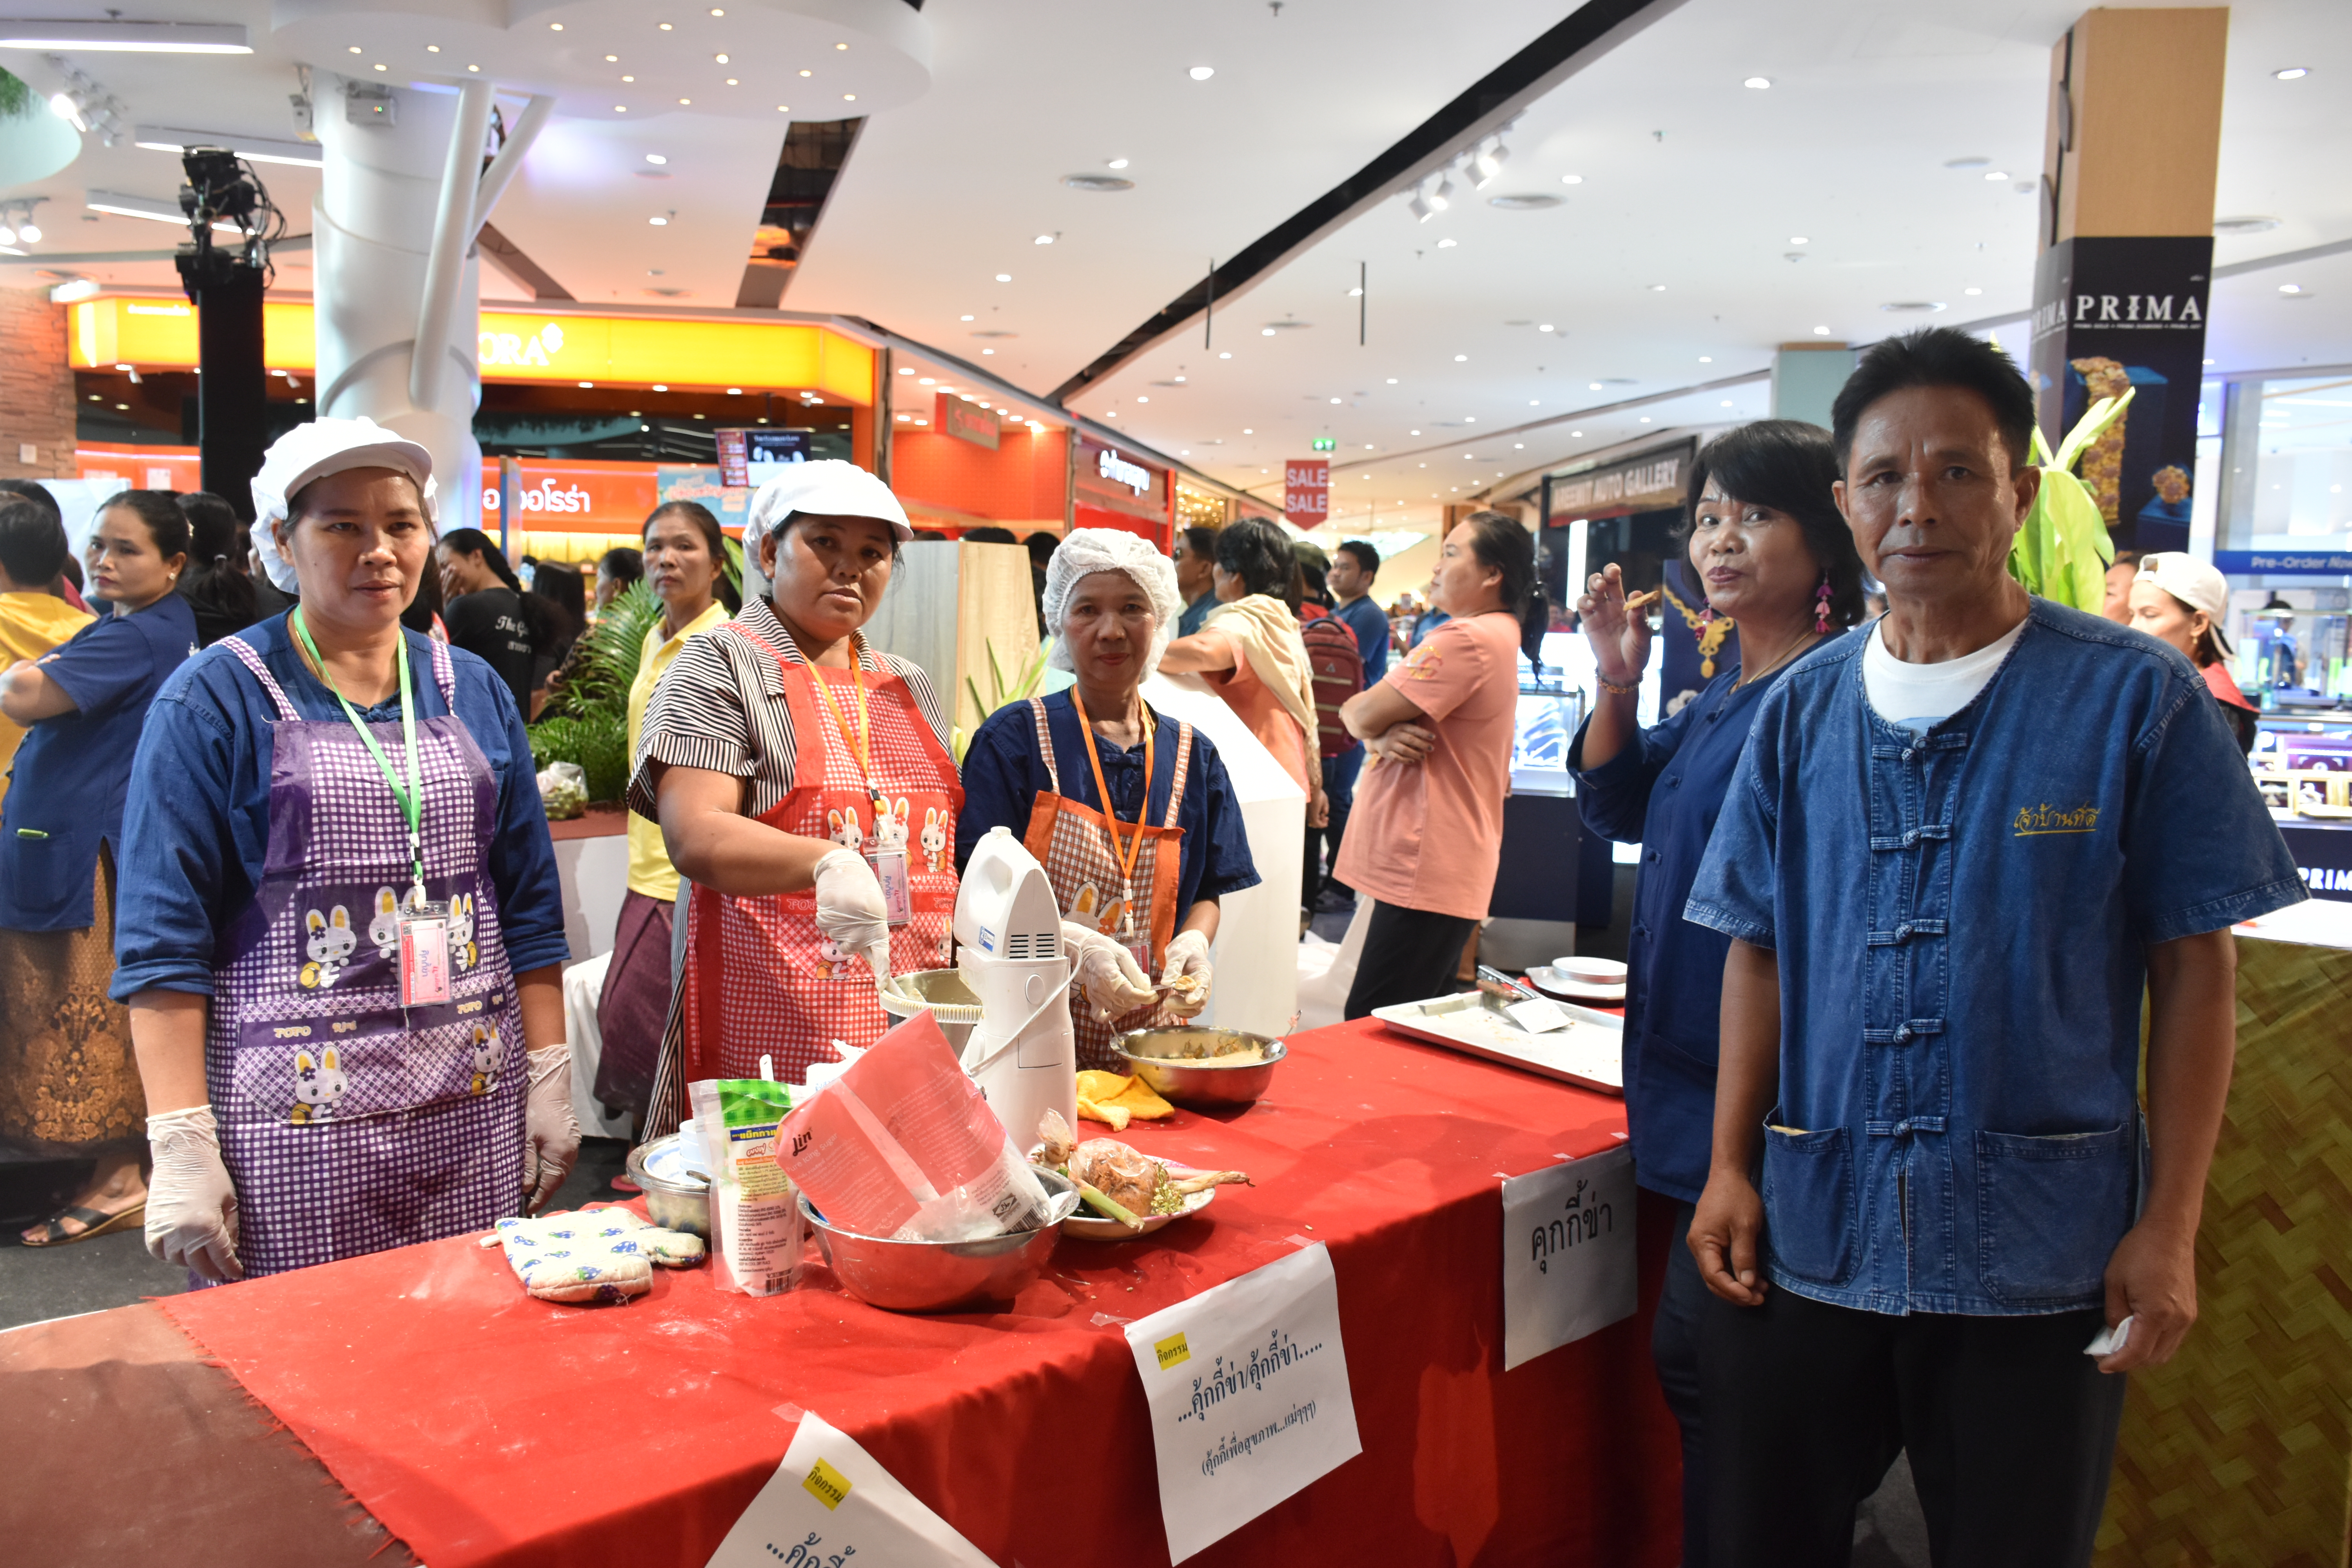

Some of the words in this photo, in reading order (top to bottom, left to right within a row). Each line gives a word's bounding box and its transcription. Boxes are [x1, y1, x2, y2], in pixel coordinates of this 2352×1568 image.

[2075, 294, 2201, 321] PRIMA
[1286, 468, 1327, 487] SALE
[1625, 459, 1680, 497] GALLERY
[1286, 494, 1327, 513] SALE
[2251, 556, 2326, 569] Pre-Order
[274, 1025, 312, 1038] POPO
[792, 1127, 813, 1157] Lin
[802, 1149, 820, 1163] Icing
[819, 1133, 839, 1151] Sugar
[1532, 1180, 1612, 1274] คุกกี้ข่า
[1158, 1343, 1189, 1364] กิจกรรม
[808, 1466, 844, 1503] กิจกรรม
